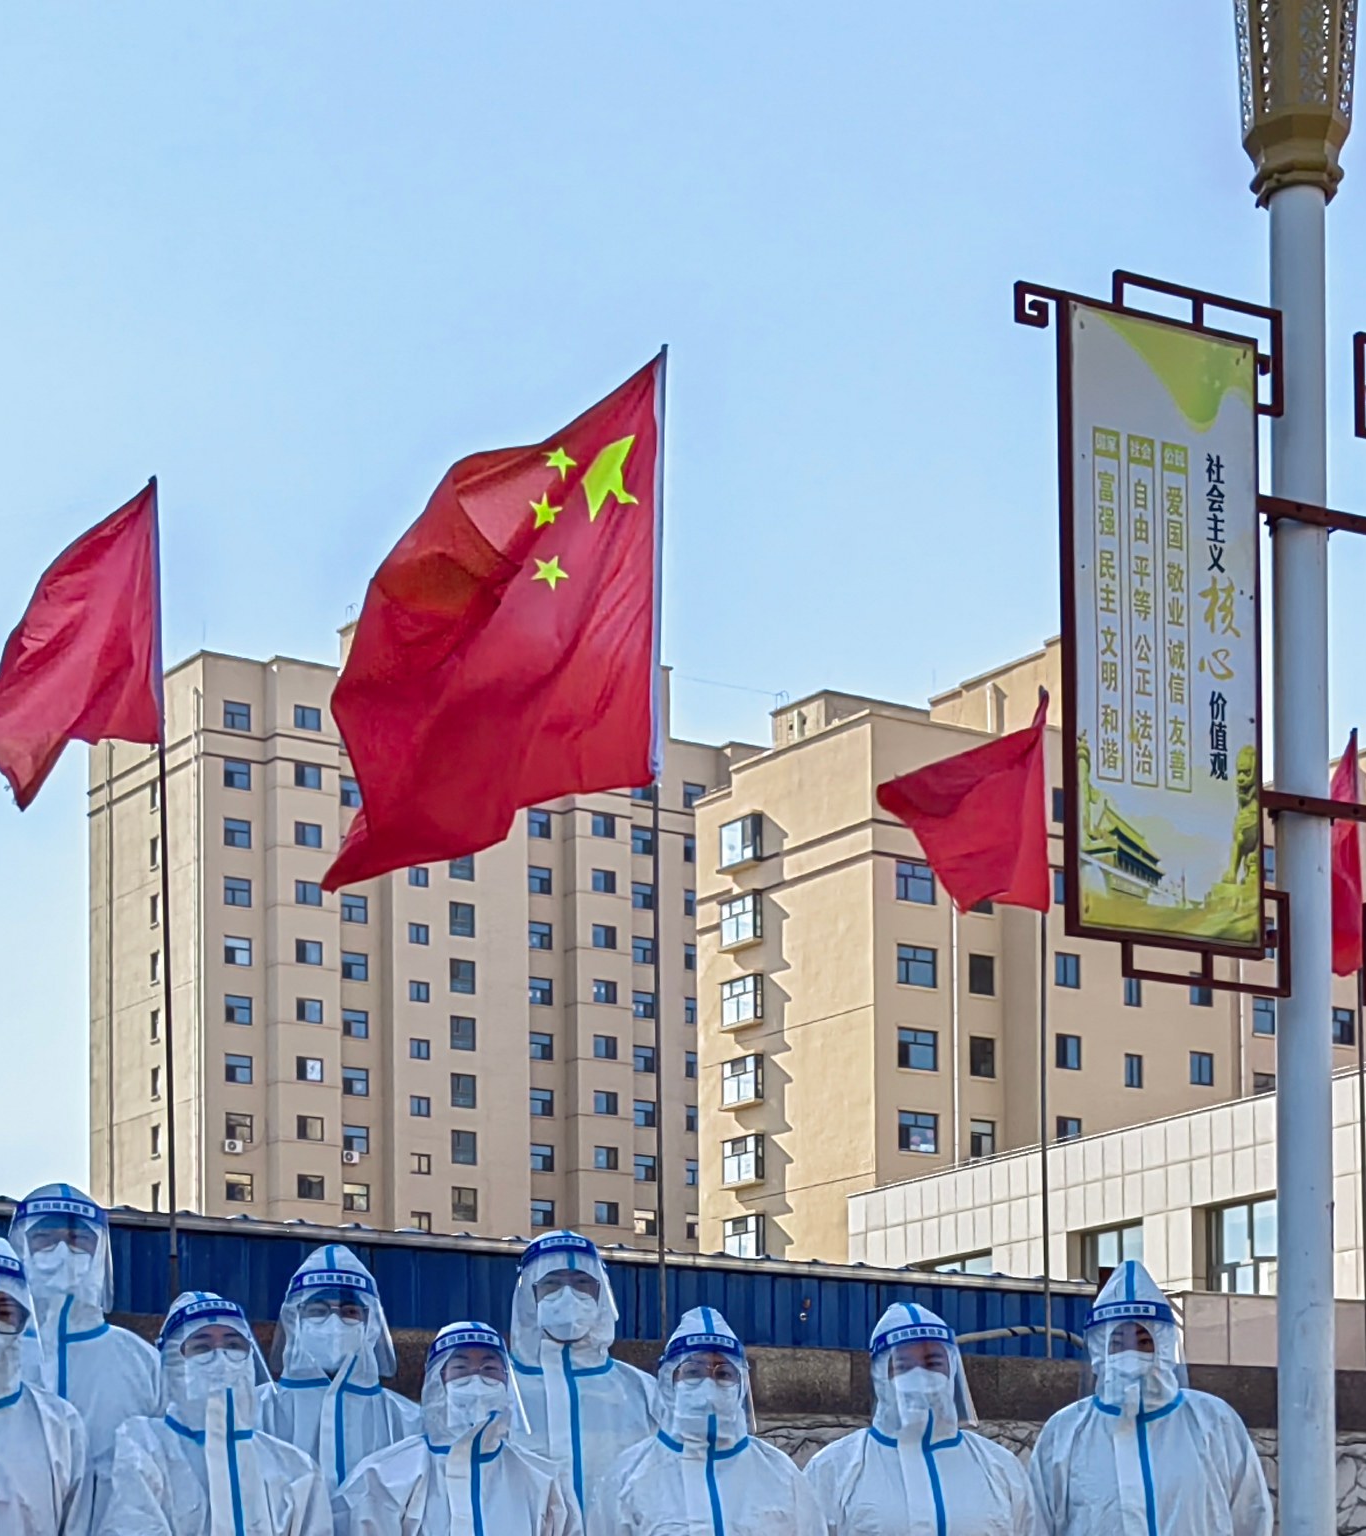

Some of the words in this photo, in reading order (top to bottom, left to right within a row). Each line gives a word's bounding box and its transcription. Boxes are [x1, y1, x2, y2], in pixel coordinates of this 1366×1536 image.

[1098, 470, 1116, 538] 富强
[1133, 478, 1149, 545] 自由
[1166, 485, 1183, 552] 爱国
[1099, 550, 1117, 615] 民主
[1133, 555, 1152, 622] 平等
[1167, 562, 1185, 628] 敬业
[1100, 626, 1118, 693] 文明
[1134, 633, 1153, 697] 公正
[1167, 638, 1185, 705] 诚信
[1100, 703, 1118, 772] 和谐
[1135, 709, 1153, 776] 法治
[1169, 715, 1186, 782] 友善
